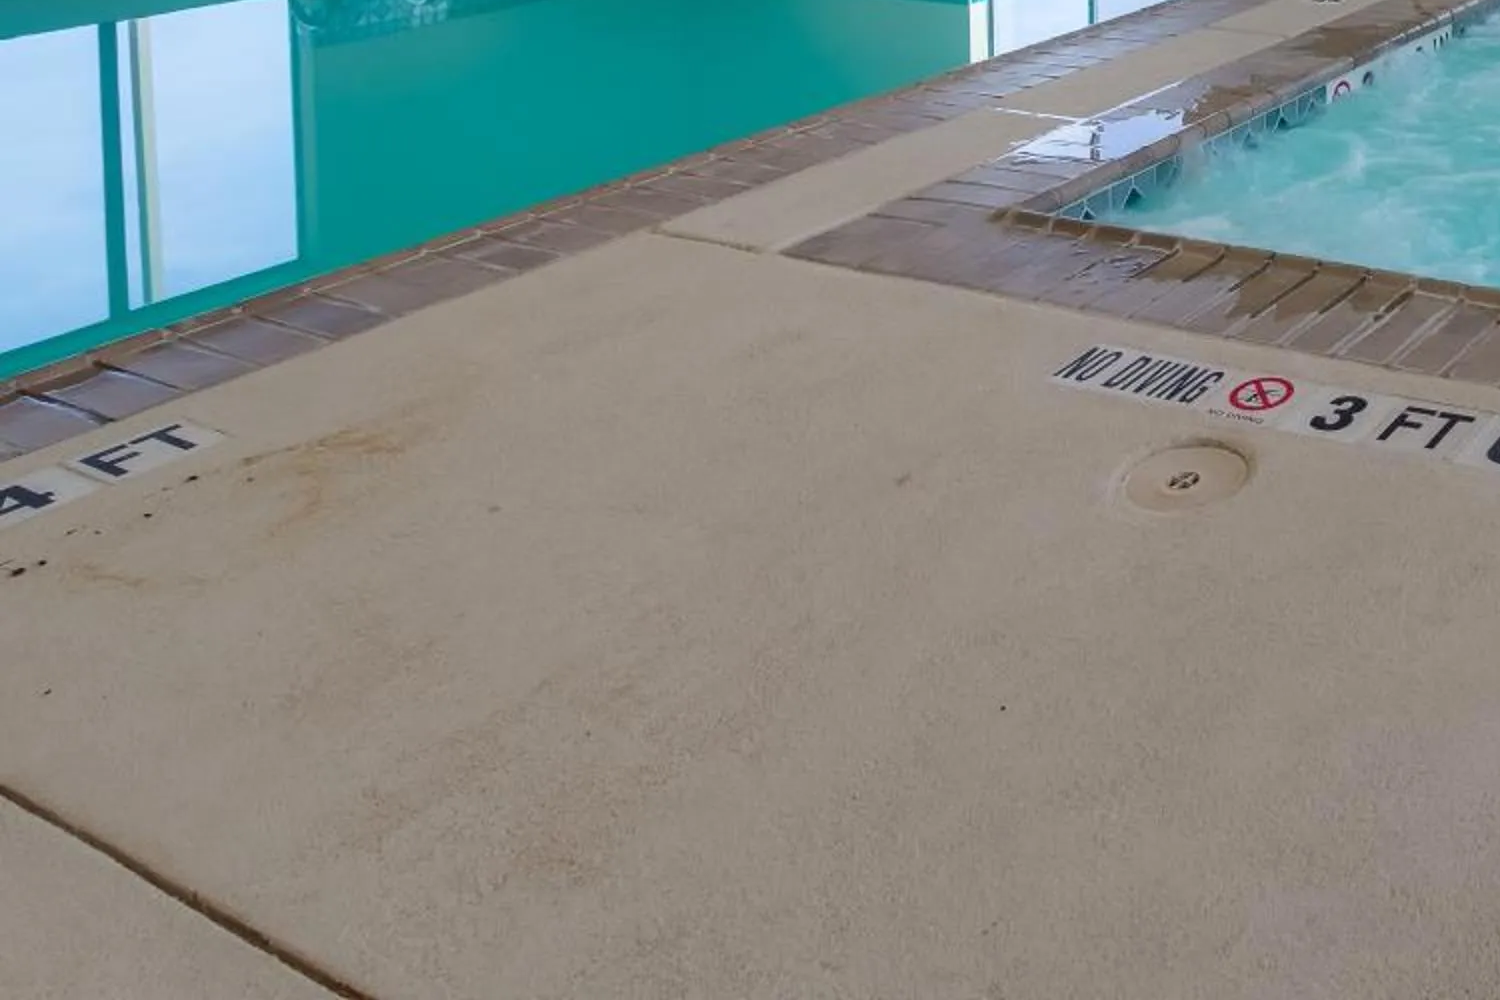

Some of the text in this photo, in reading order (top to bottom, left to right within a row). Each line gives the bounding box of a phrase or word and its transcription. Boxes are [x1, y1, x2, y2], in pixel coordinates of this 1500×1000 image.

[1052, 346, 1124, 382] NO
[1101, 355, 1226, 404] DIVING
[1309, 395, 1369, 431] 3
[1376, 405, 1476, 450] FT
[79, 423, 199, 478] FT
